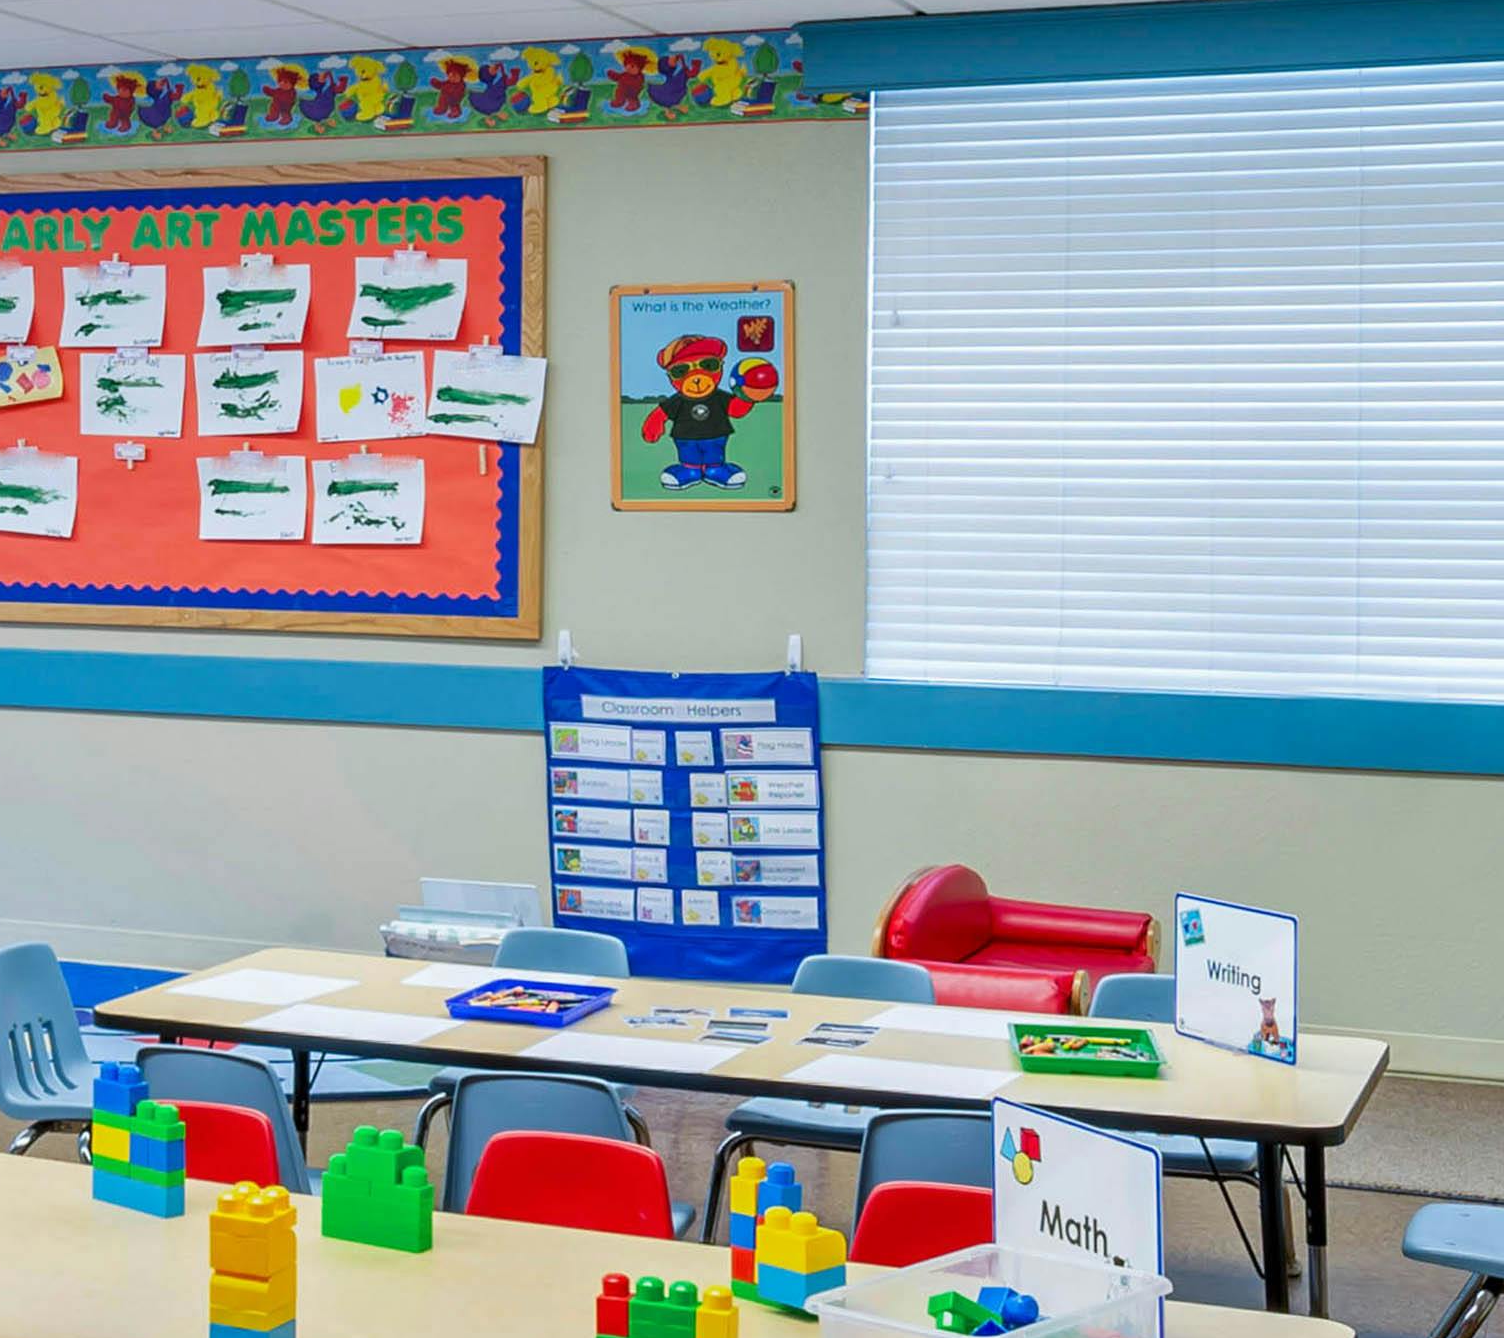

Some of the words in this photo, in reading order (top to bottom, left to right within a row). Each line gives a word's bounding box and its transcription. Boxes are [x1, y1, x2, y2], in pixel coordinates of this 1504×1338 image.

[131, 211, 220, 249] ART
[239, 204, 466, 248] MASTERS
[632, 301, 666, 313] What
[670, 300, 680, 312] is
[682, 300, 705, 312] the
[707, 298, 771, 311] Weather?
[601, 700, 674, 716] Classroom
[687, 703, 742, 718] Helpers
[1207, 960, 1261, 995] Writing
[1039, 1199, 1108, 1258] Math
